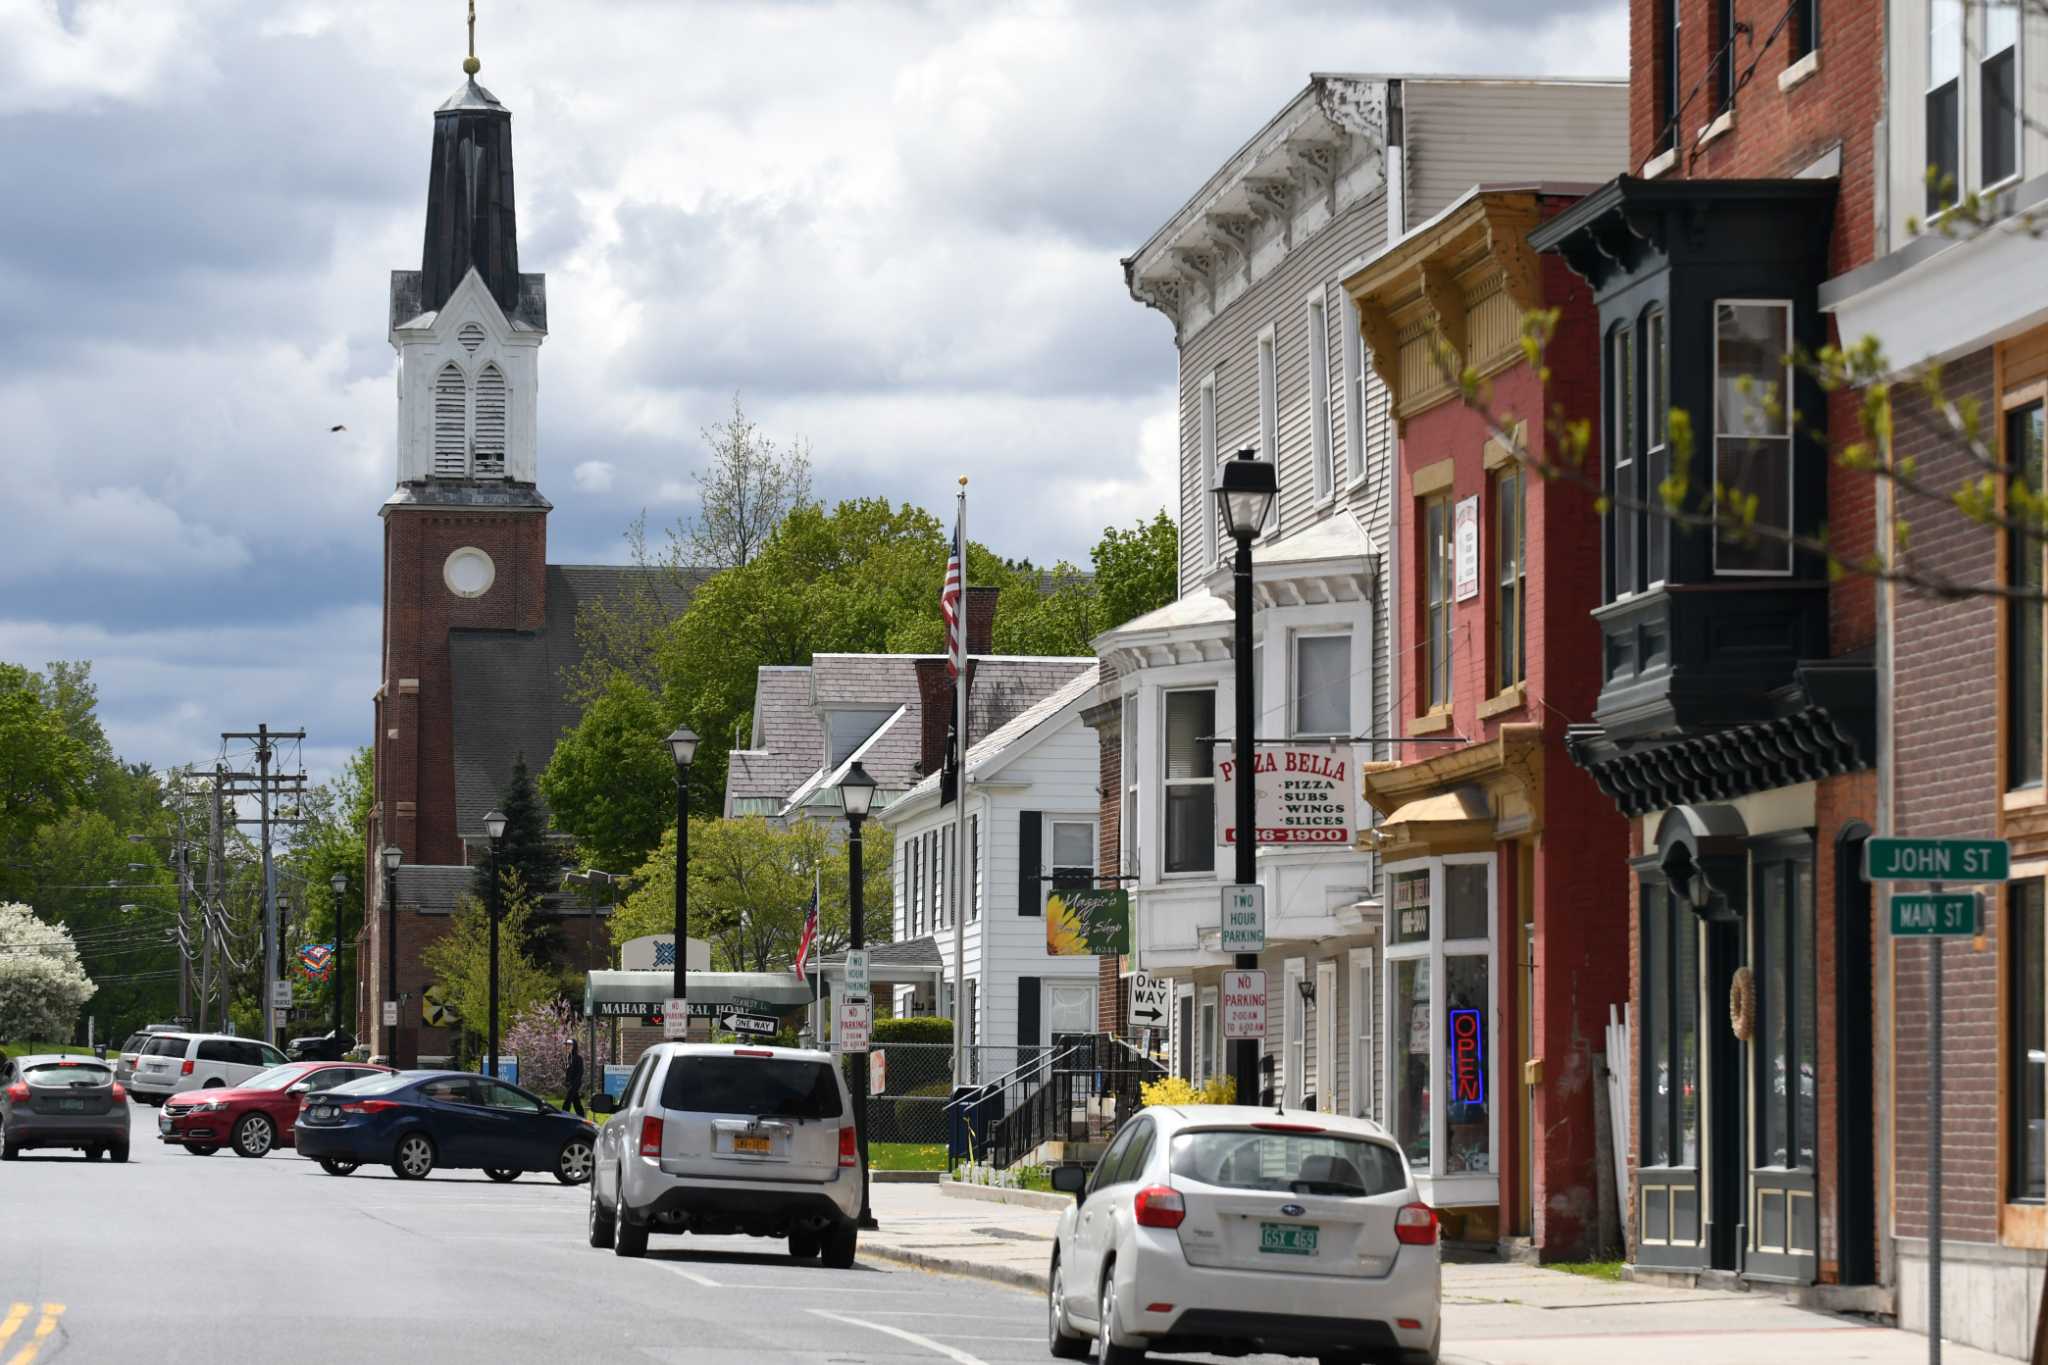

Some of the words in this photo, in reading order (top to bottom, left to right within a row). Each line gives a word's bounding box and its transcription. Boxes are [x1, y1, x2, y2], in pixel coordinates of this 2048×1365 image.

[1219, 752, 1278, 782] PZA
[1285, 752, 1345, 781] BELLA
[1284, 781, 1335, 789] PIZZA
[1284, 793, 1328, 801] SUBS
[1285, 805, 1345, 813] WINGS
[1285, 816, 1344, 825] SLICES
[1887, 847, 1951, 872] JOHN
[1962, 847, 1992, 872] ST
[1233, 895, 1254, 908] TWO
[1230, 912, 1256, 925] HOUR
[1900, 903, 1937, 927] MAIN
[1944, 903, 1964, 927] ST
[1224, 930, 1263, 943] PARKING
[1136, 974, 1167, 989] ONE
[1237, 976, 1251, 989] NO
[1135, 990, 1166, 1004] WAY
[1225, 994, 1265, 1006] PARKING
[602, 1003, 647, 1015] MAHAR
[736, 1019, 751, 1029] ONE
[753, 1021, 770, 1032] WAY
[1455, 1015, 1478, 1100] OPEN
